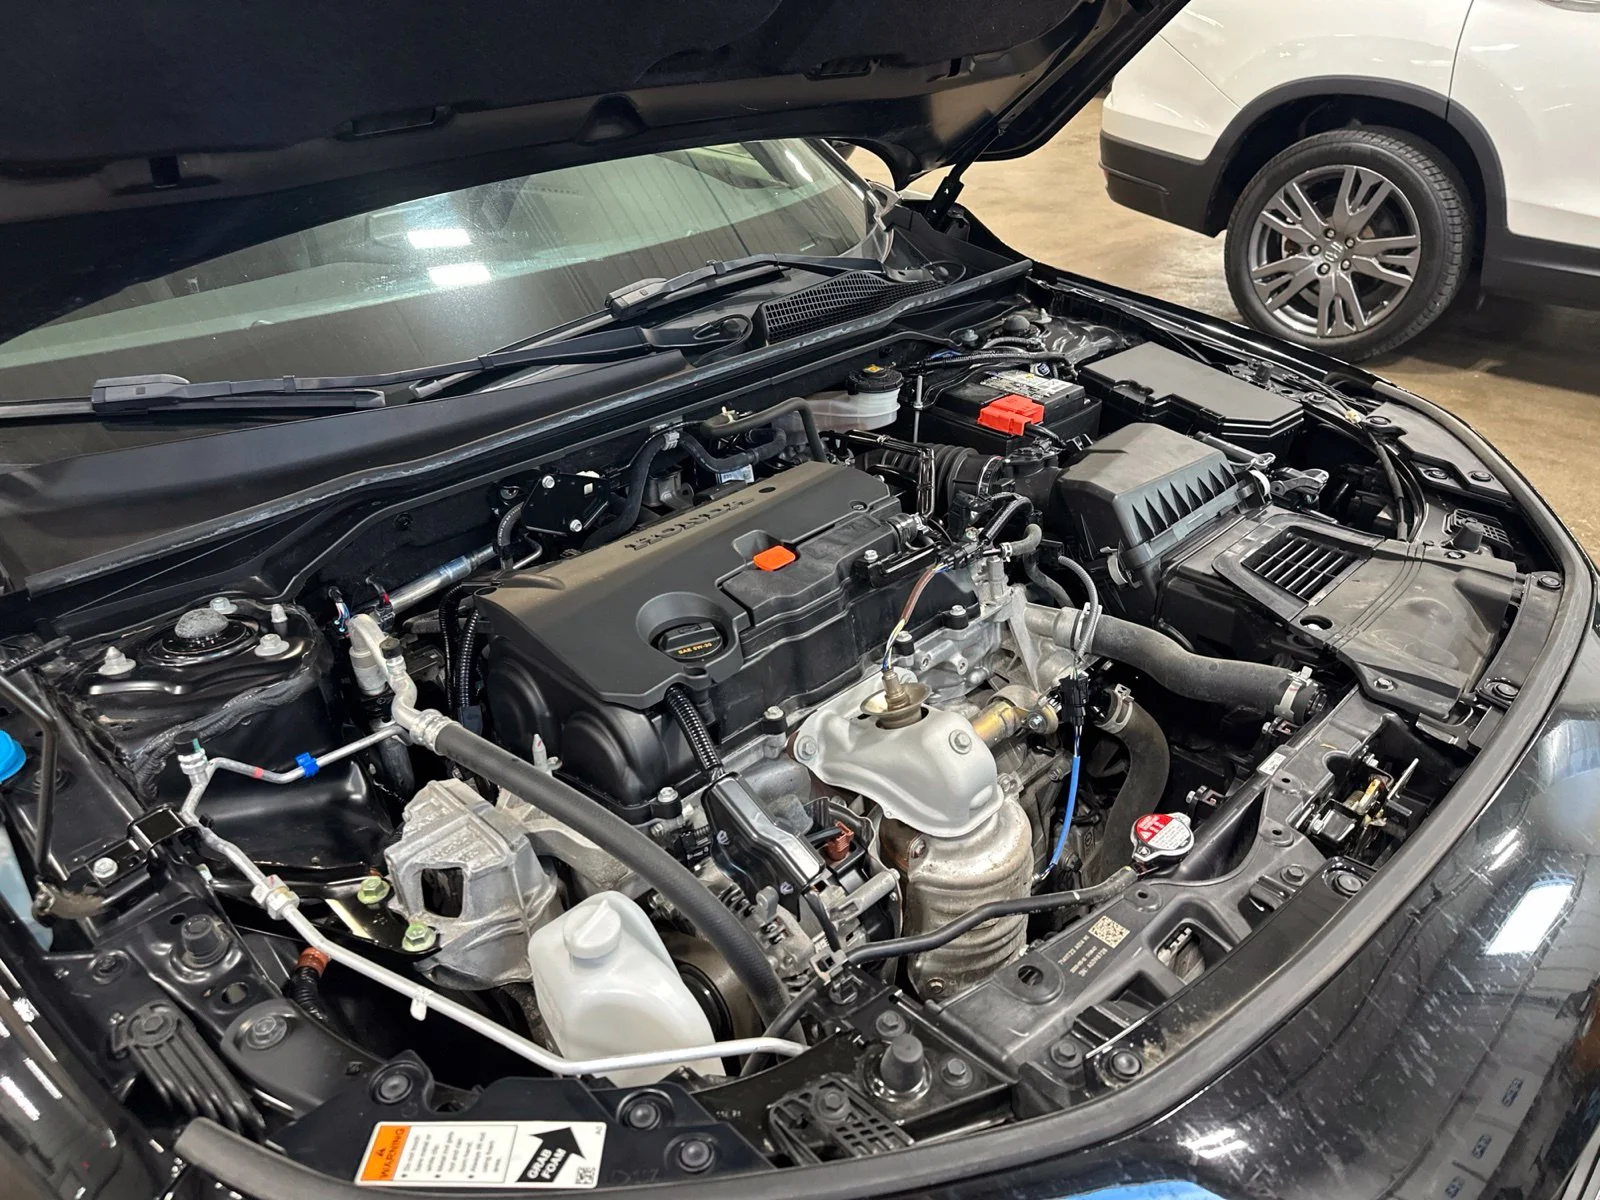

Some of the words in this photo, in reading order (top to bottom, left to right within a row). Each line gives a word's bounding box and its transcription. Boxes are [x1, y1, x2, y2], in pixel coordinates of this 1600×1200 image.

[380, 1128, 405, 1178] WARNING
[527, 1149, 552, 1178] GRAB
[541, 1148, 566, 1178] FOAM
